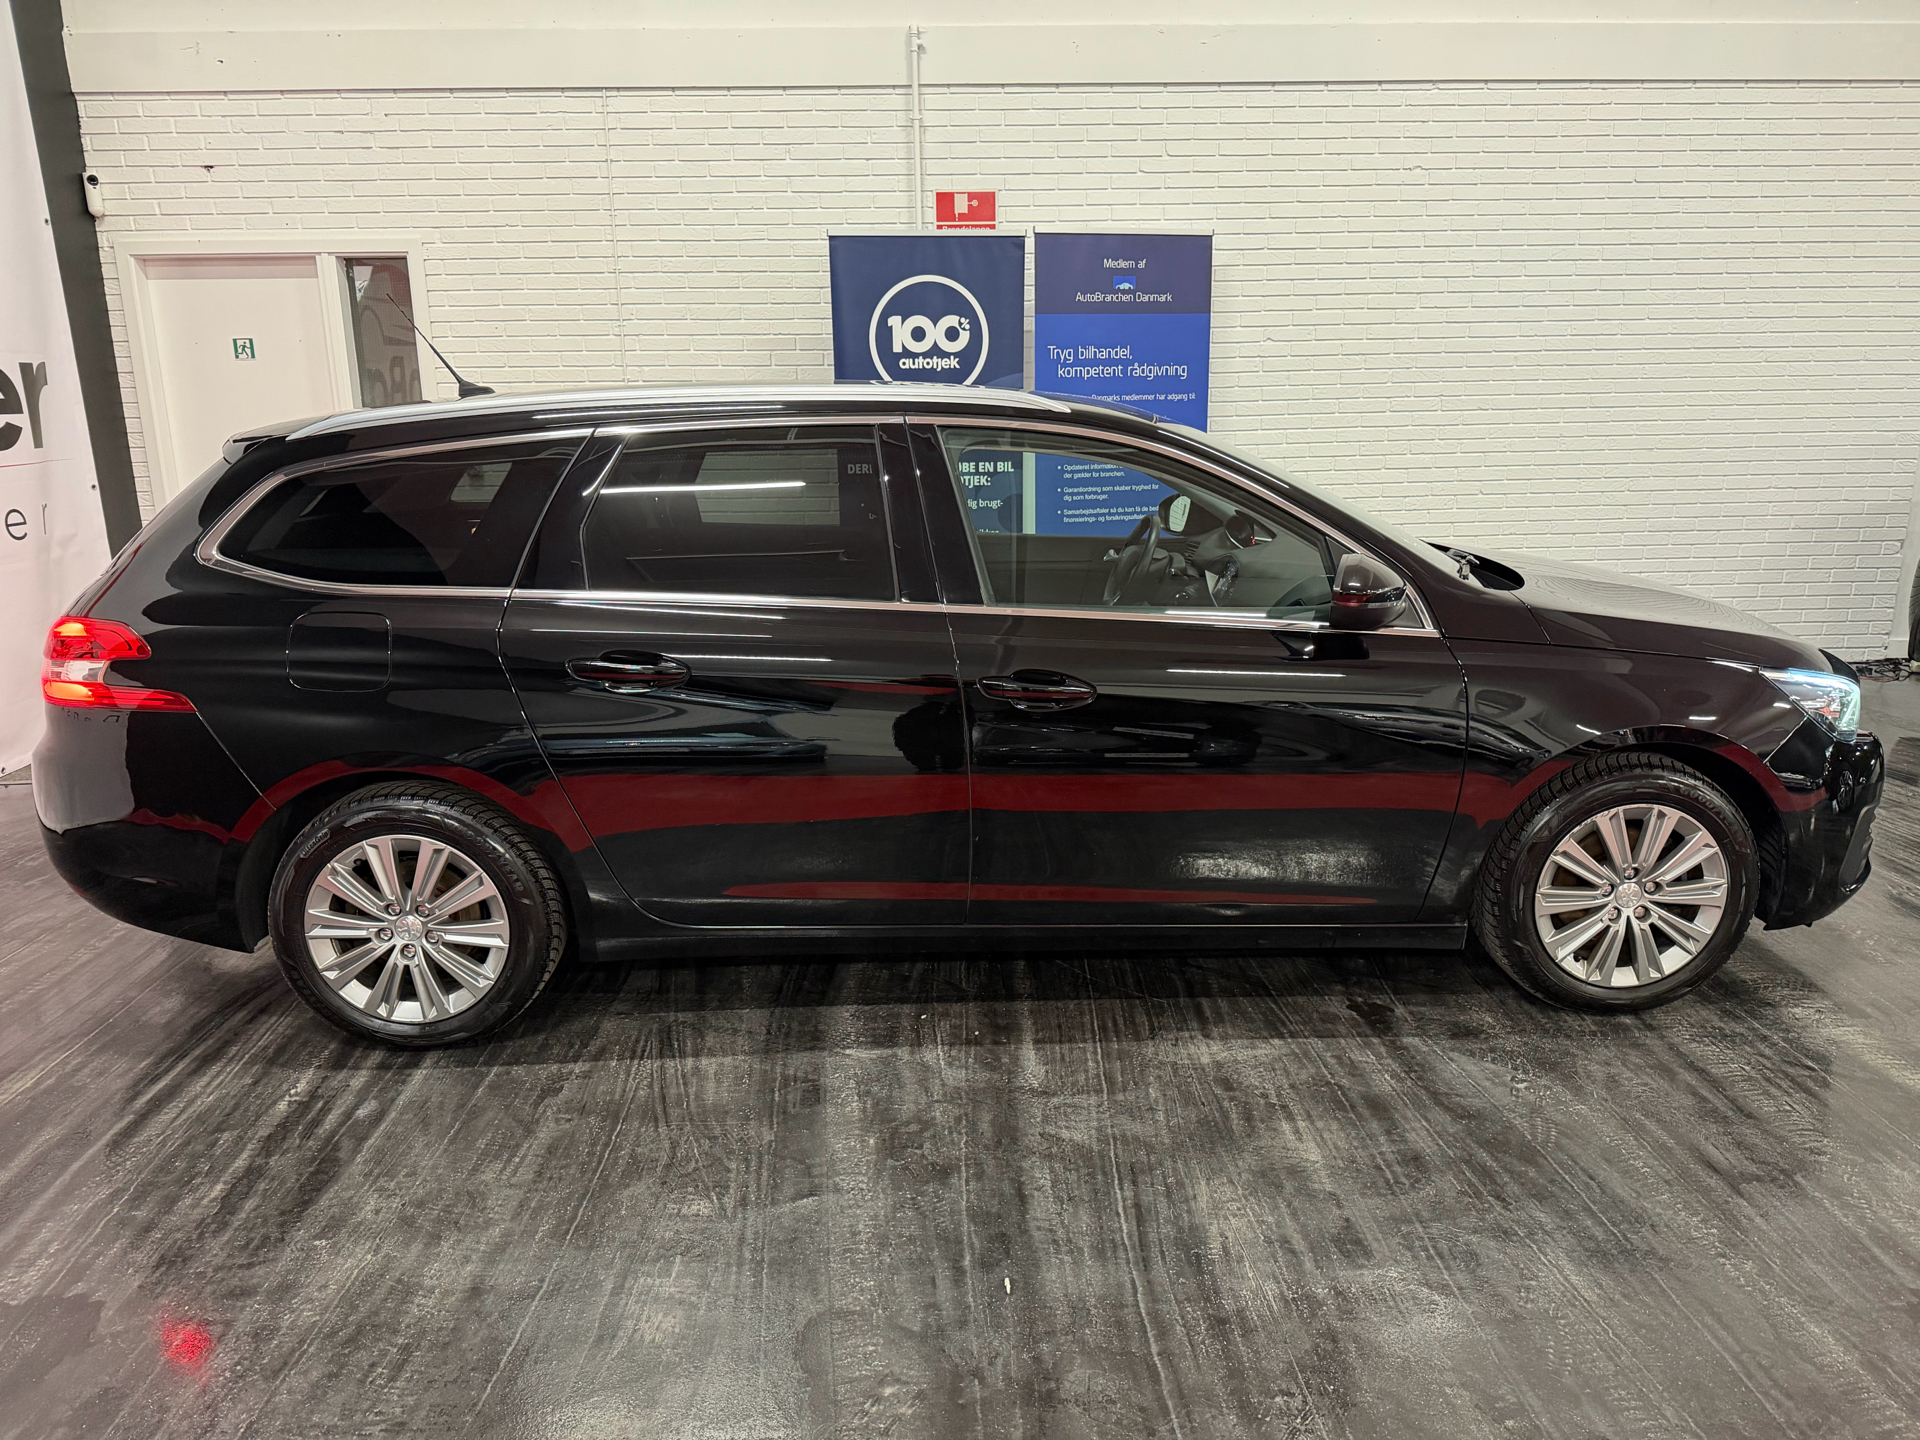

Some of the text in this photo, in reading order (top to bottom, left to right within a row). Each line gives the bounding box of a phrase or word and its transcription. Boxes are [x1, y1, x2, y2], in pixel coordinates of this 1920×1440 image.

[1103, 258, 1147, 269] Medlem af
[1075, 291, 1173, 302] AutoBranchen Danmark
[887, 314, 971, 353] 100%
[1047, 345, 1133, 363] Tryg bilhandel,
[898, 355, 961, 372] autotjek
[1058, 362, 1187, 380] kompetent rådgivning
[1121, 393, 1155, 401] medlemmer
[1167, 392, 1188, 402] adgang
[958, 460, 1015, 473] BE EN BIL
[1063, 464, 1090, 472] Opdateret
[960, 474, 991, 489] TJEK:
[1114, 484, 1132, 492] skaber
[1063, 494, 1072, 502] dig
[979, 498, 1004, 510] brugt-
[1098, 515, 1106, 523] og
